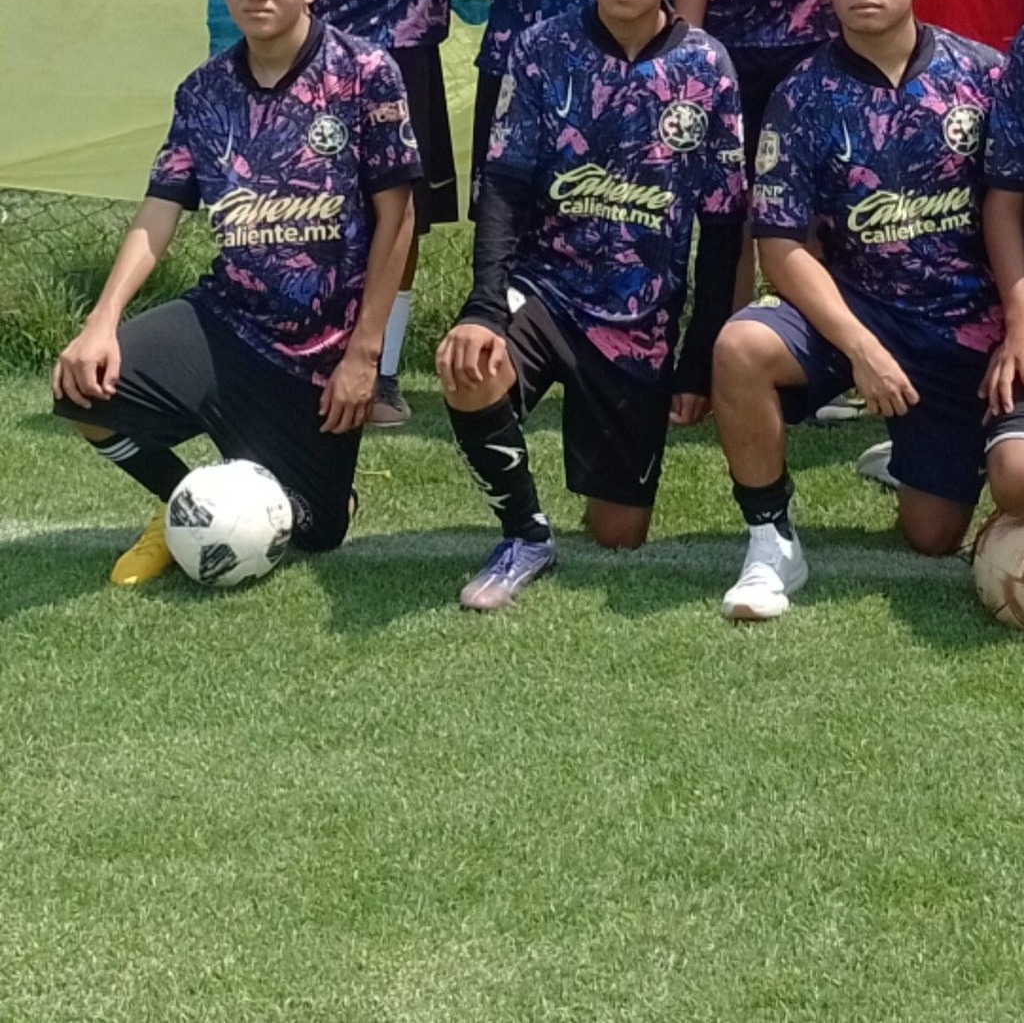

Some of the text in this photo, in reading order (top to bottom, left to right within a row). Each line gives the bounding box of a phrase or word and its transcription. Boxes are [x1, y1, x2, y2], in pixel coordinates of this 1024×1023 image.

[204, 187, 346, 232] Caliente
[550, 163, 677, 210] Caliente
[847, 186, 972, 232] Caliente
